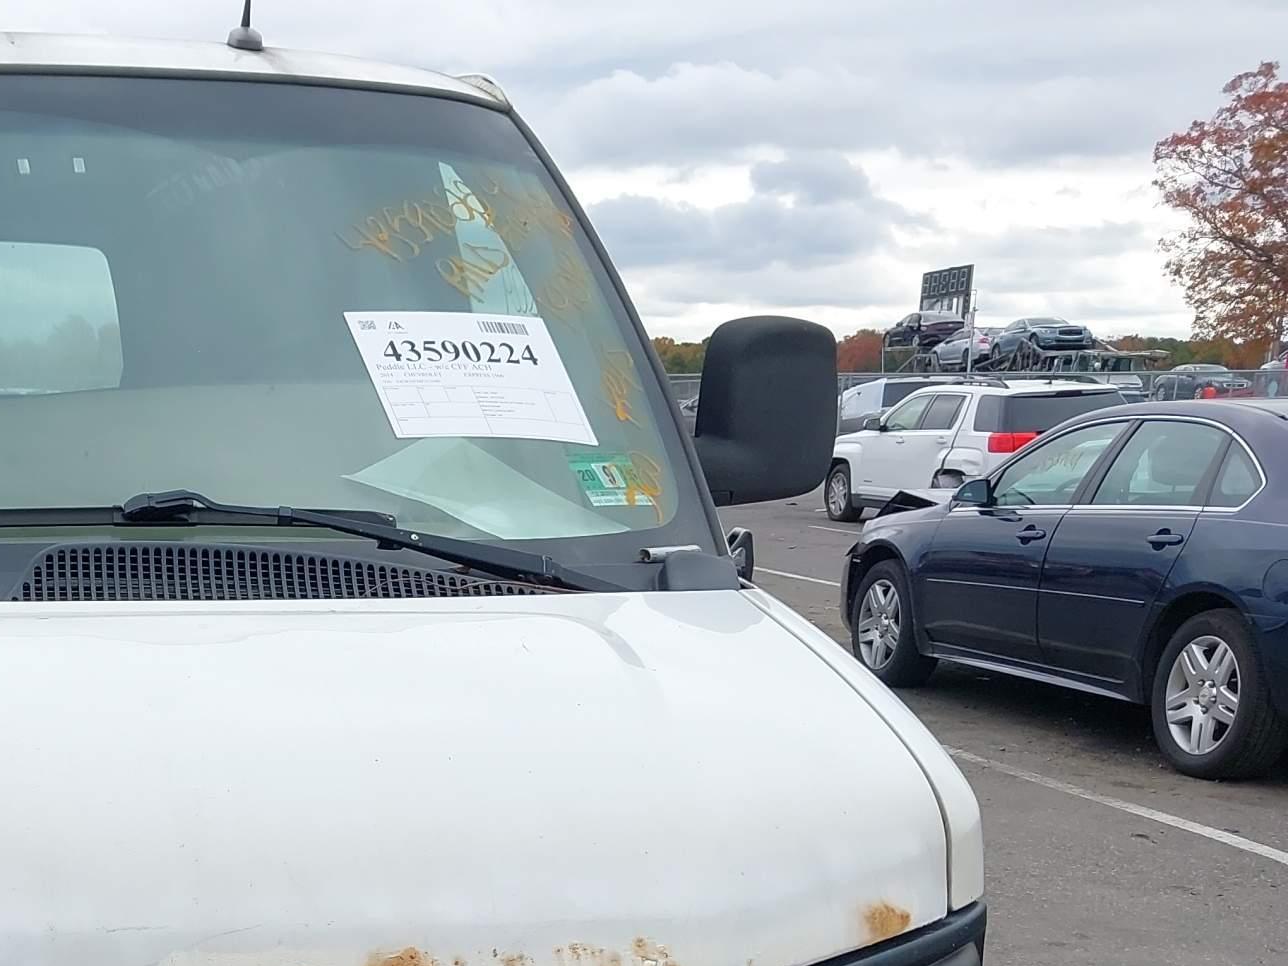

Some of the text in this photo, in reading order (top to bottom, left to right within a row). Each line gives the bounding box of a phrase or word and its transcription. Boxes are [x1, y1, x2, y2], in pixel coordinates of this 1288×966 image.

[383, 339, 539, 366] 43590224
[577, 469, 596, 482] 20
[602, 464, 618, 486] 9
